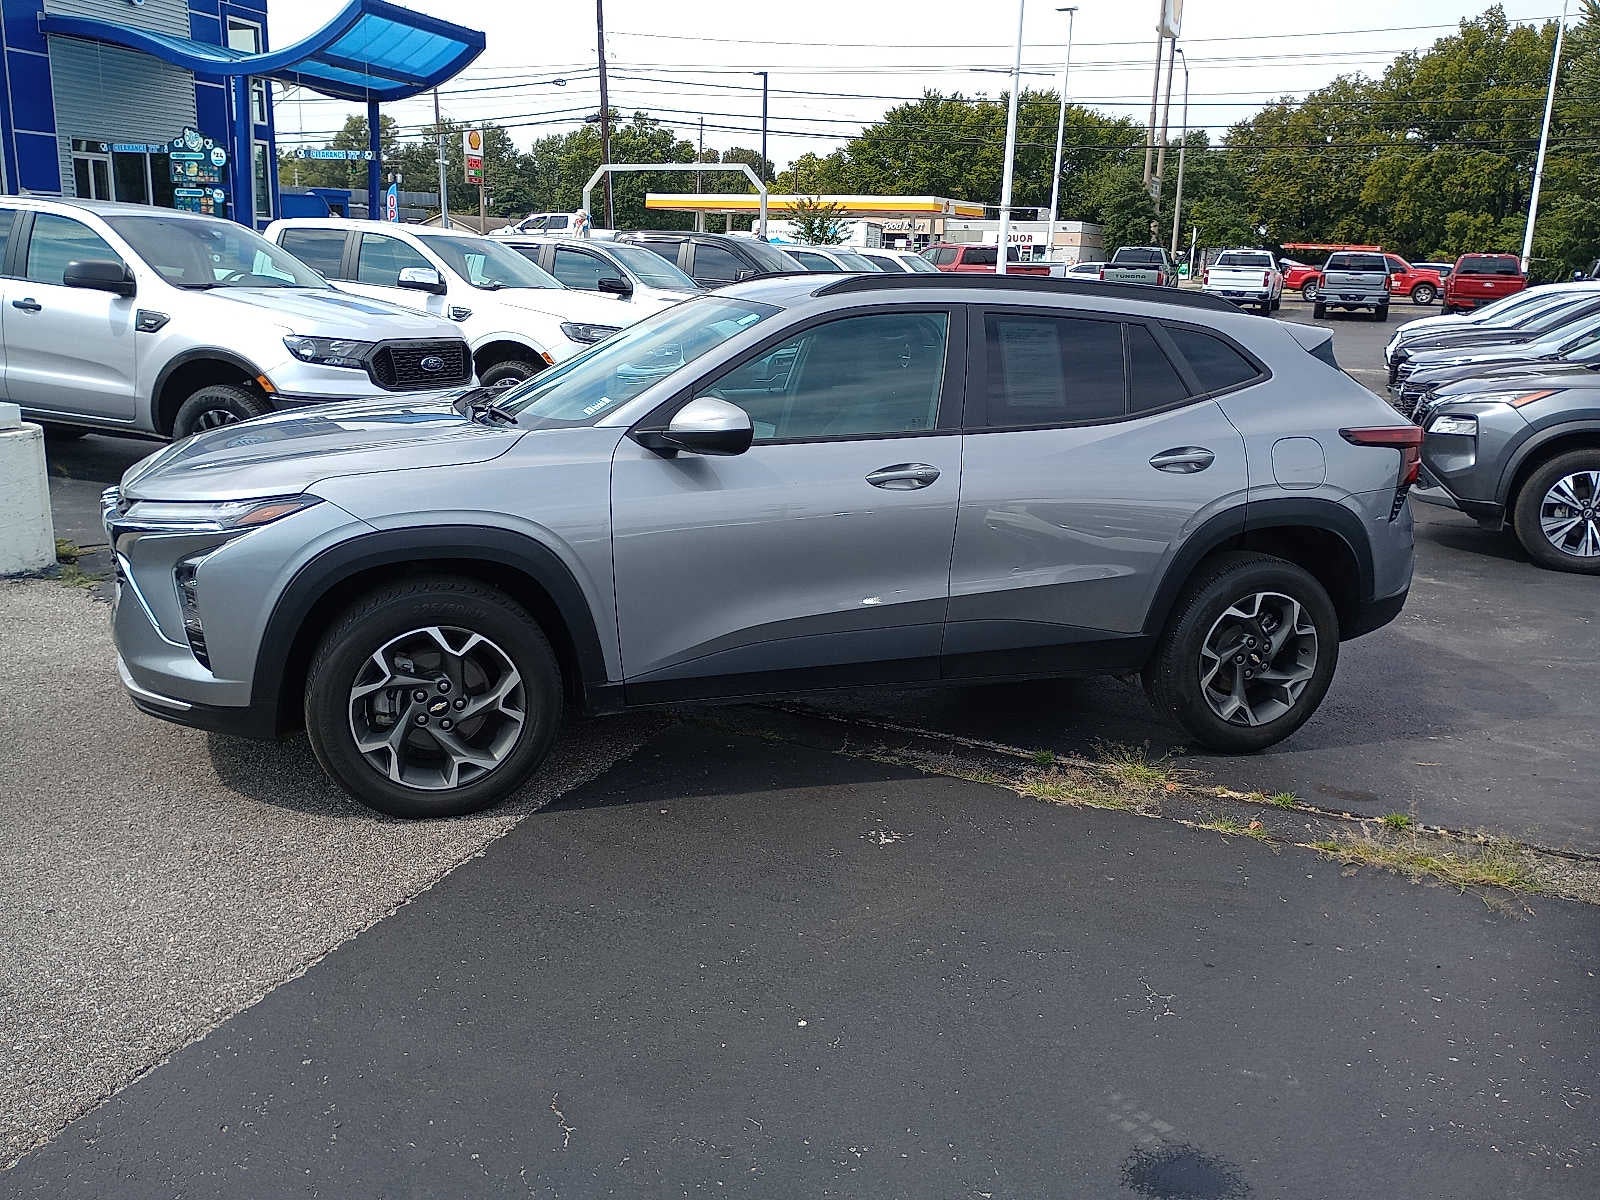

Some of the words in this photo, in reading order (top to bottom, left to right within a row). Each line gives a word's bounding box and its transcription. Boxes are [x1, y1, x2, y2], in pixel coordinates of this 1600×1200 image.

[310, 150, 346, 159] CLEARANCE
[882, 220, 902, 230] Food
[903, 221, 924, 230] Mrt
[995, 233, 1033, 244] LQUOR
